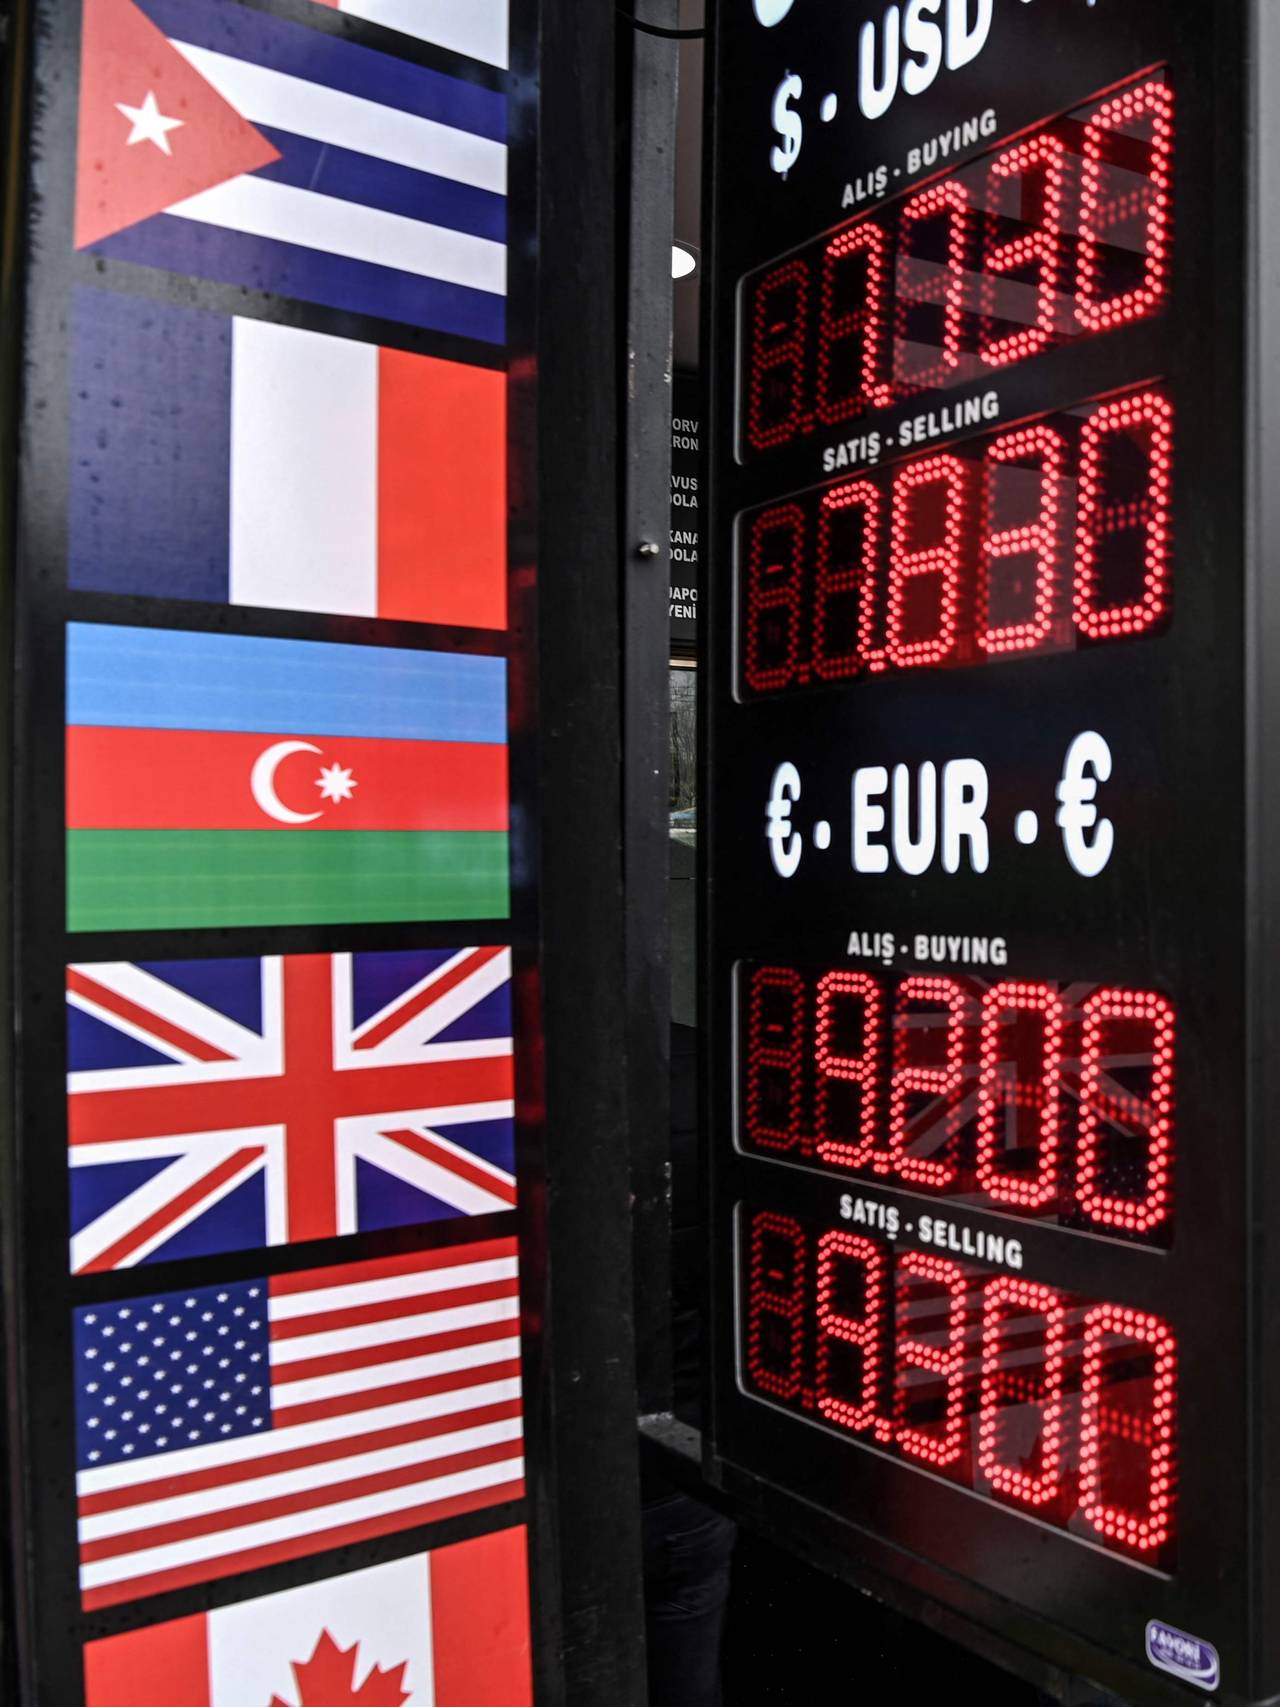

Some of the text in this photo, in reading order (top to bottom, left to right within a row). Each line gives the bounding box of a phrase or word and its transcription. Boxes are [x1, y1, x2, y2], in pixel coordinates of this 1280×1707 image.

[858, 0, 994, 120] USD
[907, 108, 997, 175] BUYING
[670, 435, 699, 451] RON
[898, 391, 1000, 448] SELLING
[670, 475, 699, 491] VUS
[851, 758, 990, 876] EUR
[914, 935, 1008, 966] BUYING
[919, 1214, 1024, 1270] SELLING
